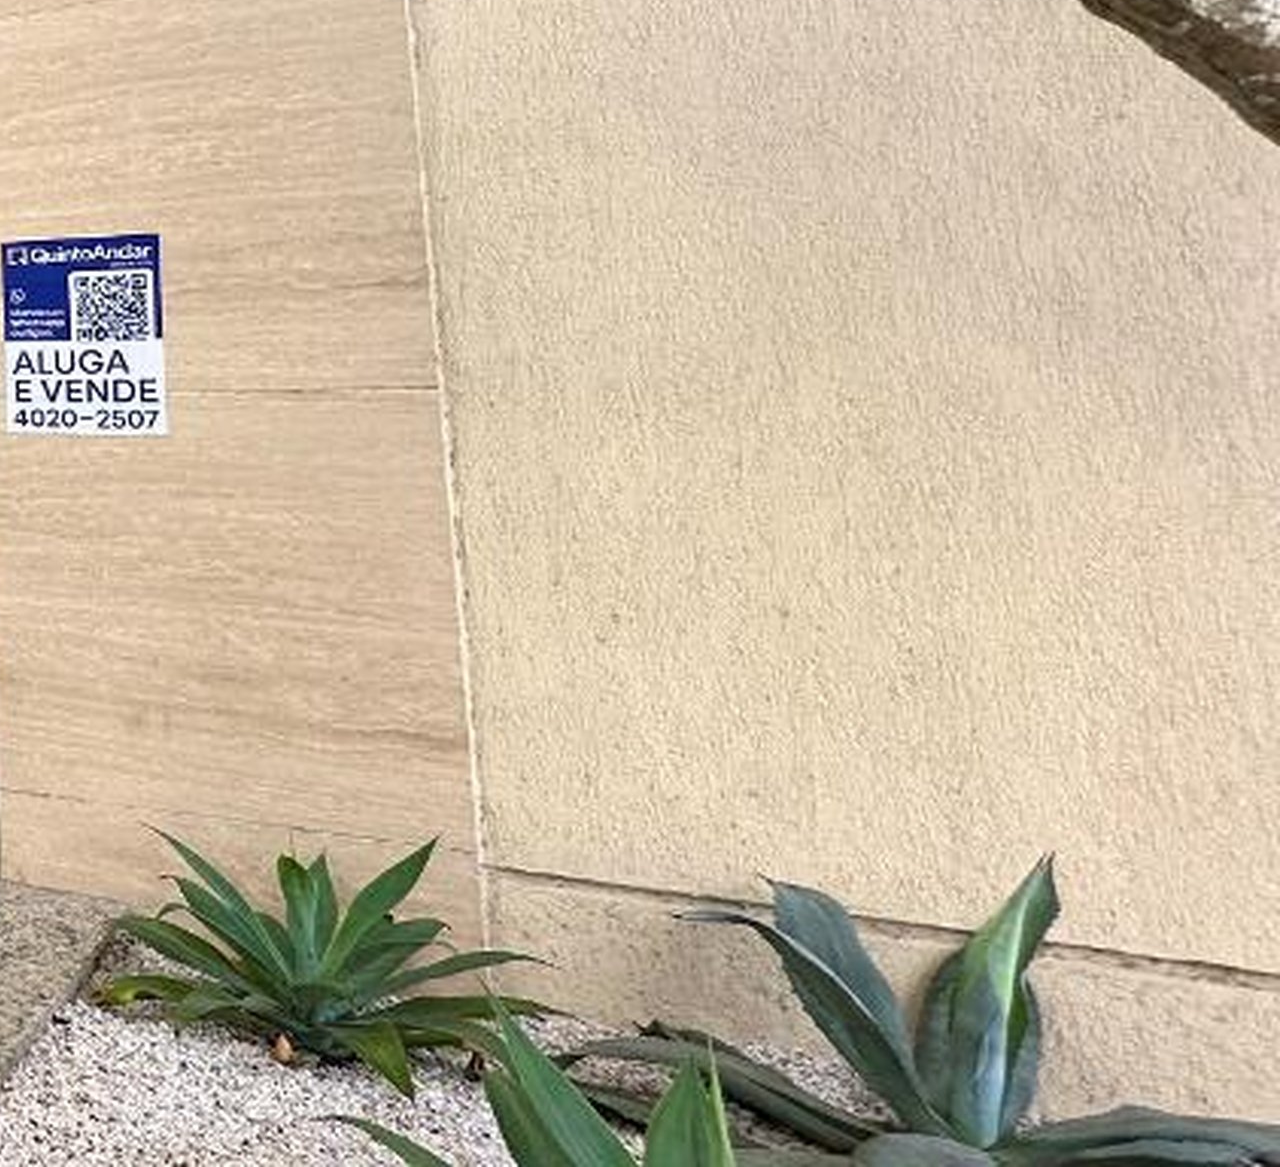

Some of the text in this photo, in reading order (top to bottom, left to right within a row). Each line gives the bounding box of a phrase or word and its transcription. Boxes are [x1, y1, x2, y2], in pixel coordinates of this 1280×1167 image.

[31, 244, 153, 264] QuintoAndar
[13, 350, 130, 375] ALUGA
[15, 379, 159, 402] E VENDE
[14, 409, 160, 429] 4020-2507
